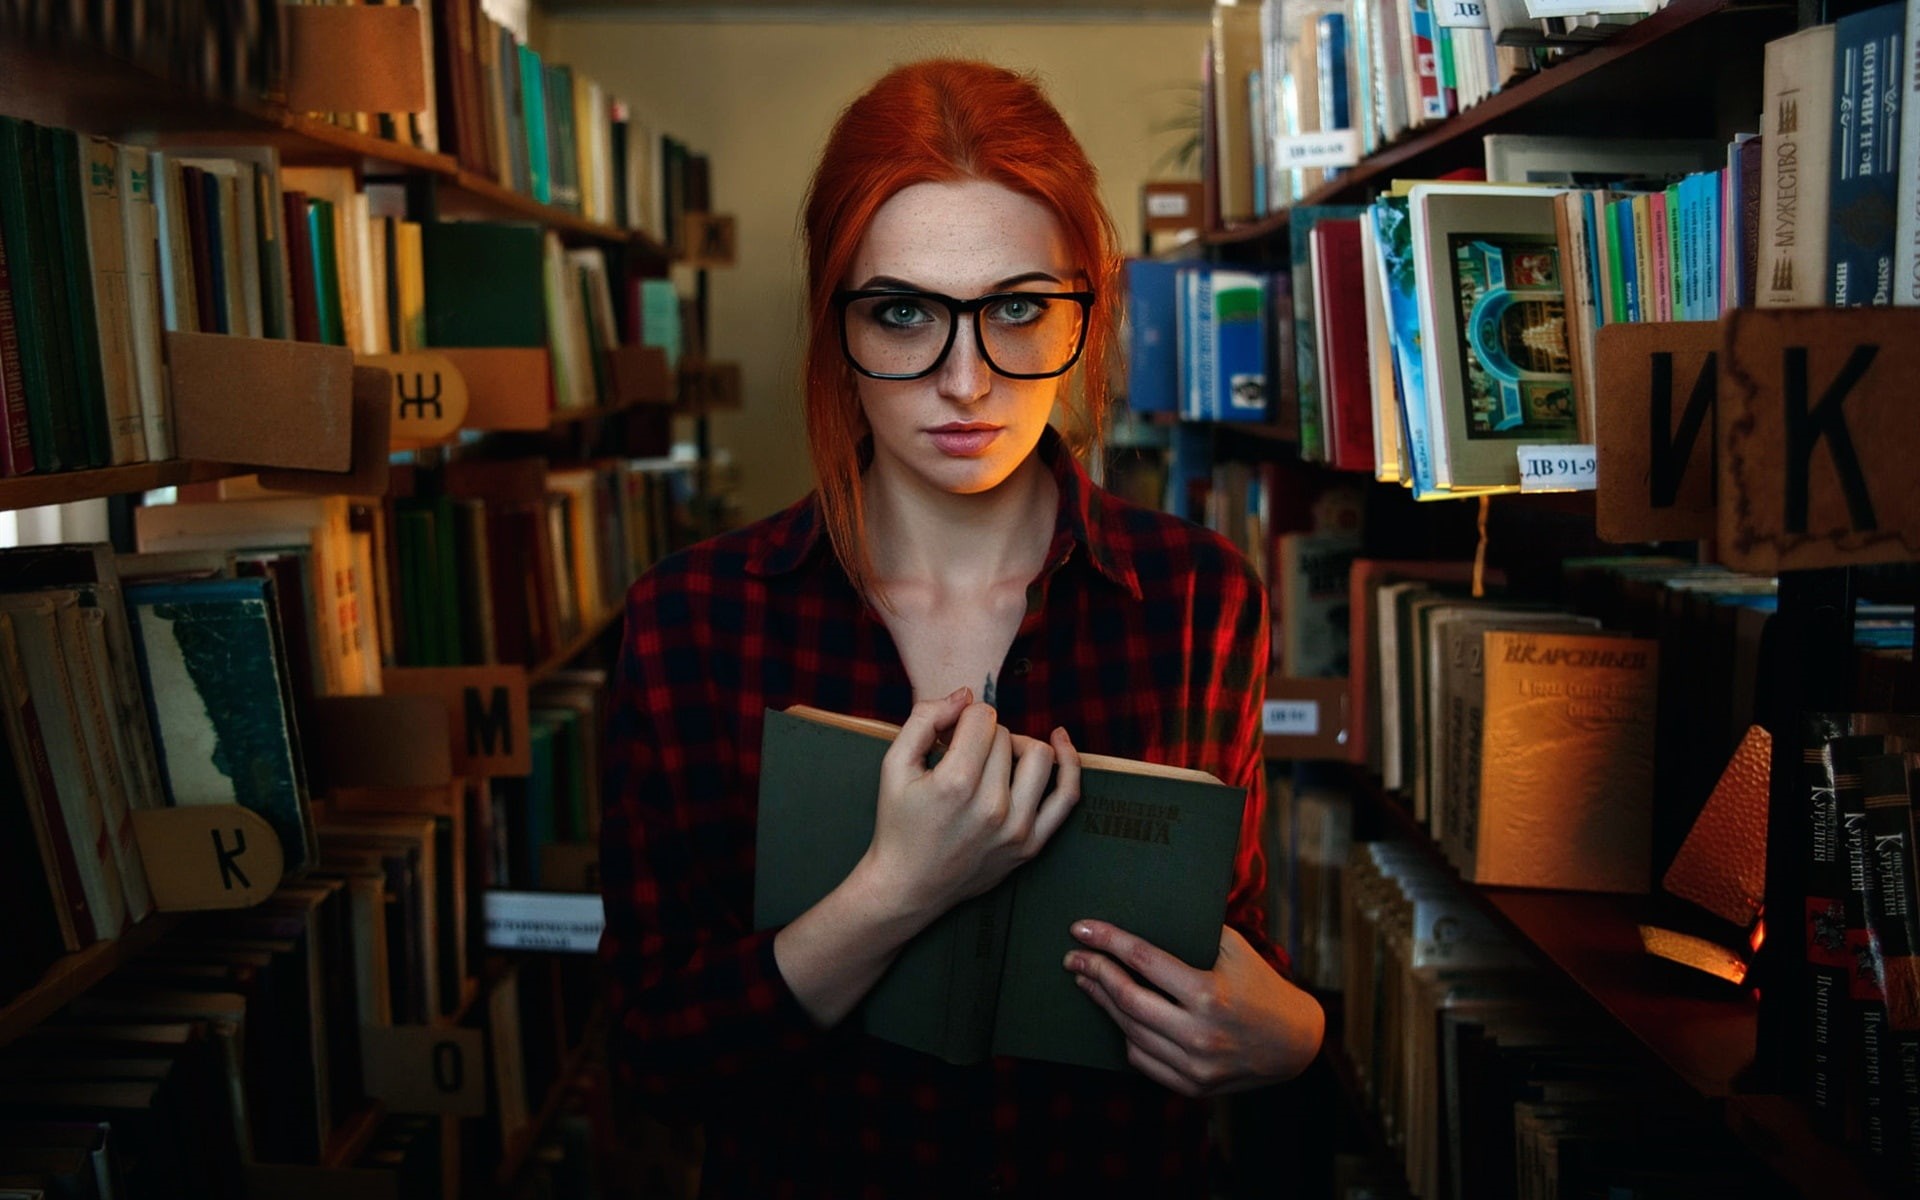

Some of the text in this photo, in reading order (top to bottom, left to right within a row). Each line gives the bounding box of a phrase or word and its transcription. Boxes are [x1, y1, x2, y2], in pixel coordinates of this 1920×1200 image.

[1454, 3, 1480, 17] ДВ
[1774, 142, 1798, 248] МУЖЕСТВО
[398, 372, 442, 420] Ж
[13, 419, 30, 449] ВСЕ
[1651, 352, 1717, 508] И
[1784, 344, 1880, 533] К
[1526, 457, 1598, 478] ДВ 91-9
[464, 687, 513, 757] М
[212, 829, 250, 890] К
[432, 1041, 462, 1092] О
